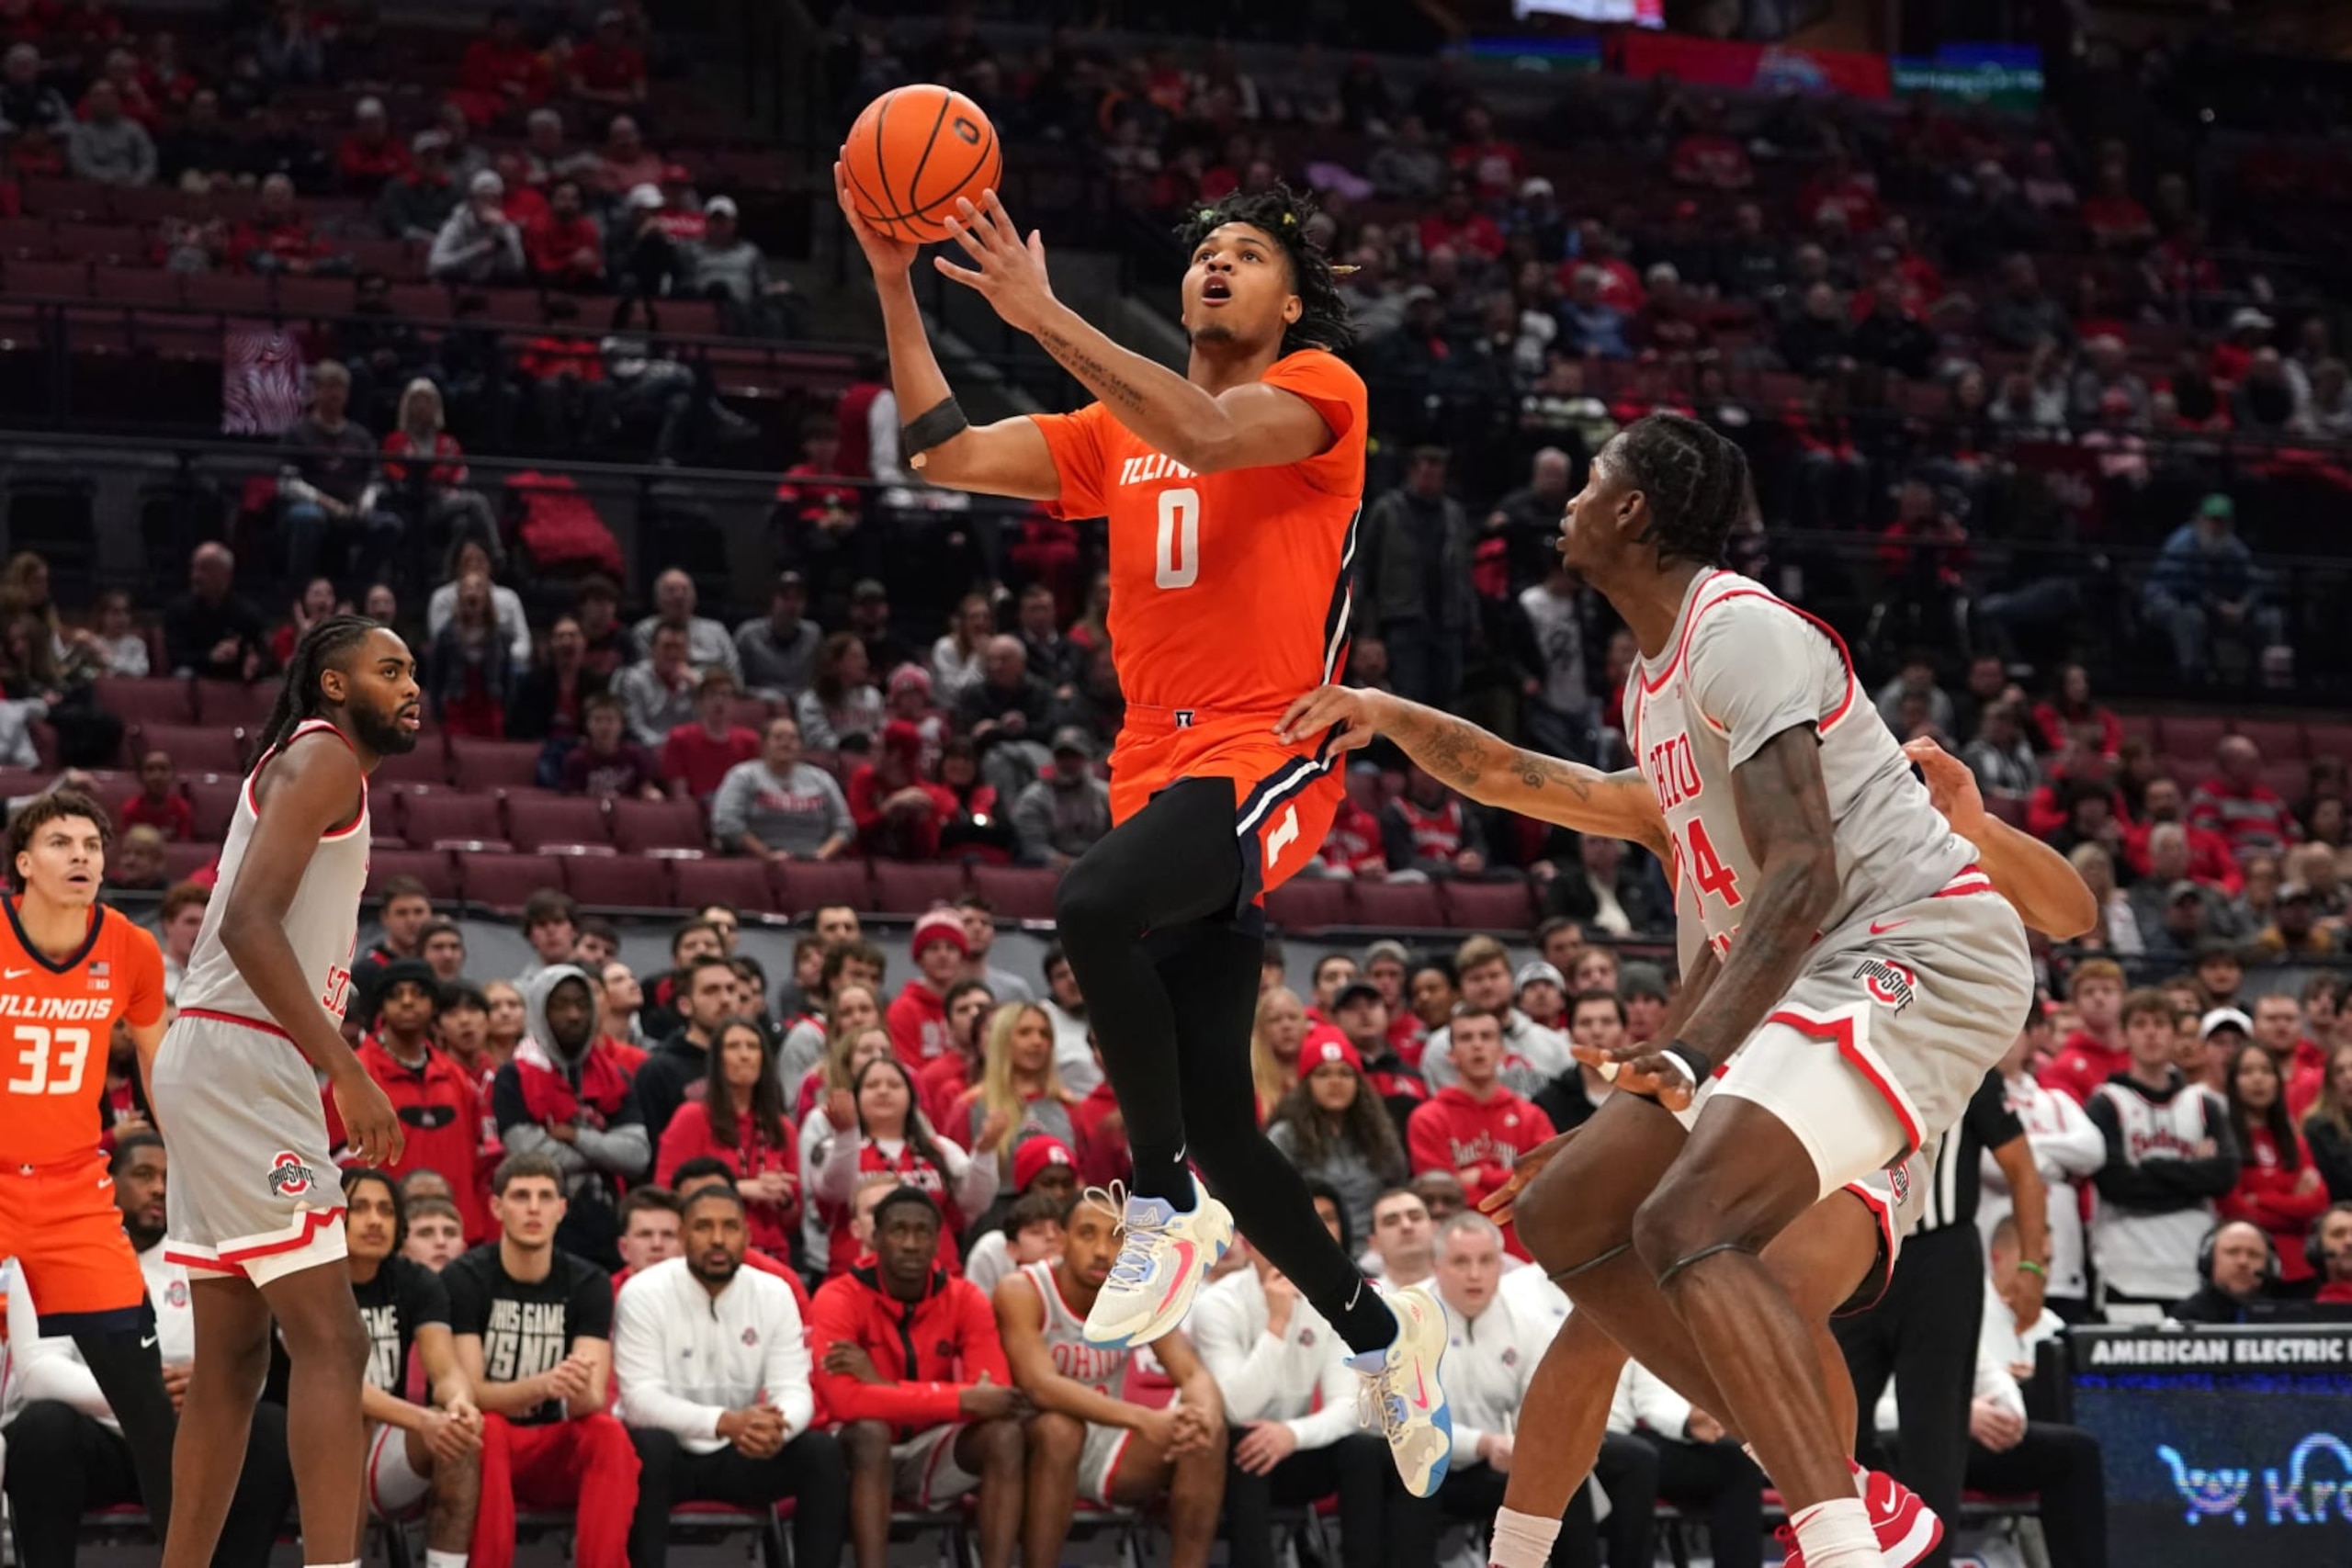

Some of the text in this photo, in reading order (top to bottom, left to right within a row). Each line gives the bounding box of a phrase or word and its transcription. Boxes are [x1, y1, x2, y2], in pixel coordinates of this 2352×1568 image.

[1119, 453, 1198, 485] ILLIN
[1156, 488, 1200, 589] 0
[1650, 731, 1703, 816] HIO
[8, 1025, 90, 1095] 33
[522, 1303, 565, 1335] GAME
[483, 1331, 519, 1381] IS
[2091, 1338, 2230, 1364] AMERICAN
[2233, 1337, 2344, 1363] ELECTRIC
